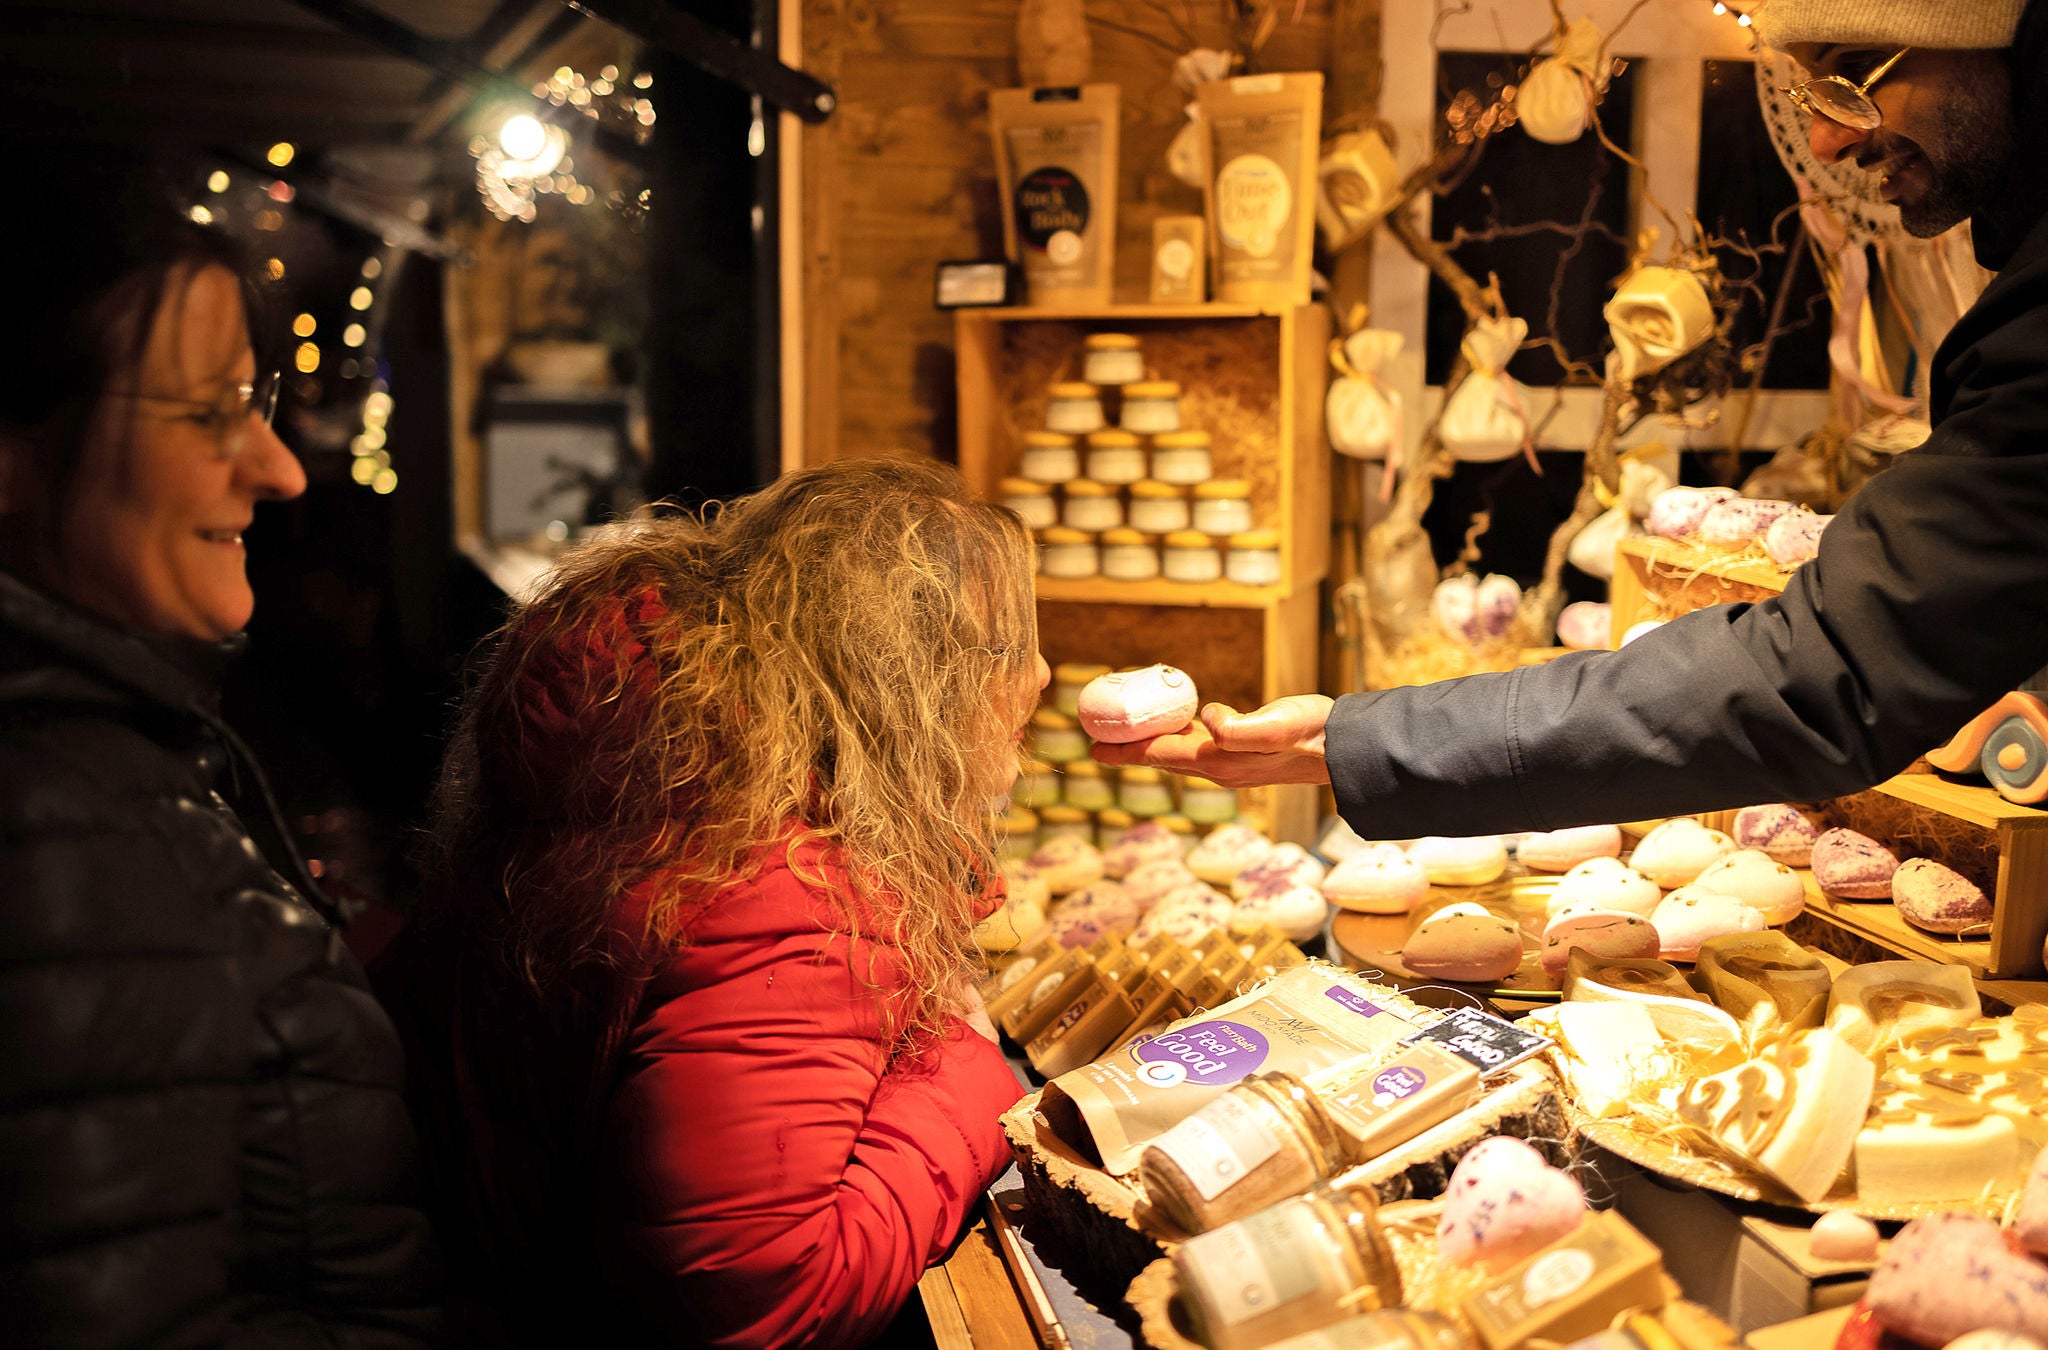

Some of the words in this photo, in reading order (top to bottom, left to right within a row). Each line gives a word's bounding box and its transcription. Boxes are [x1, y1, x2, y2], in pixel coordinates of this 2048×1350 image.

[1154, 1033, 1227, 1076] Good
[1189, 1030, 1238, 1056] Feel
[1376, 1074, 1412, 1098] Good
